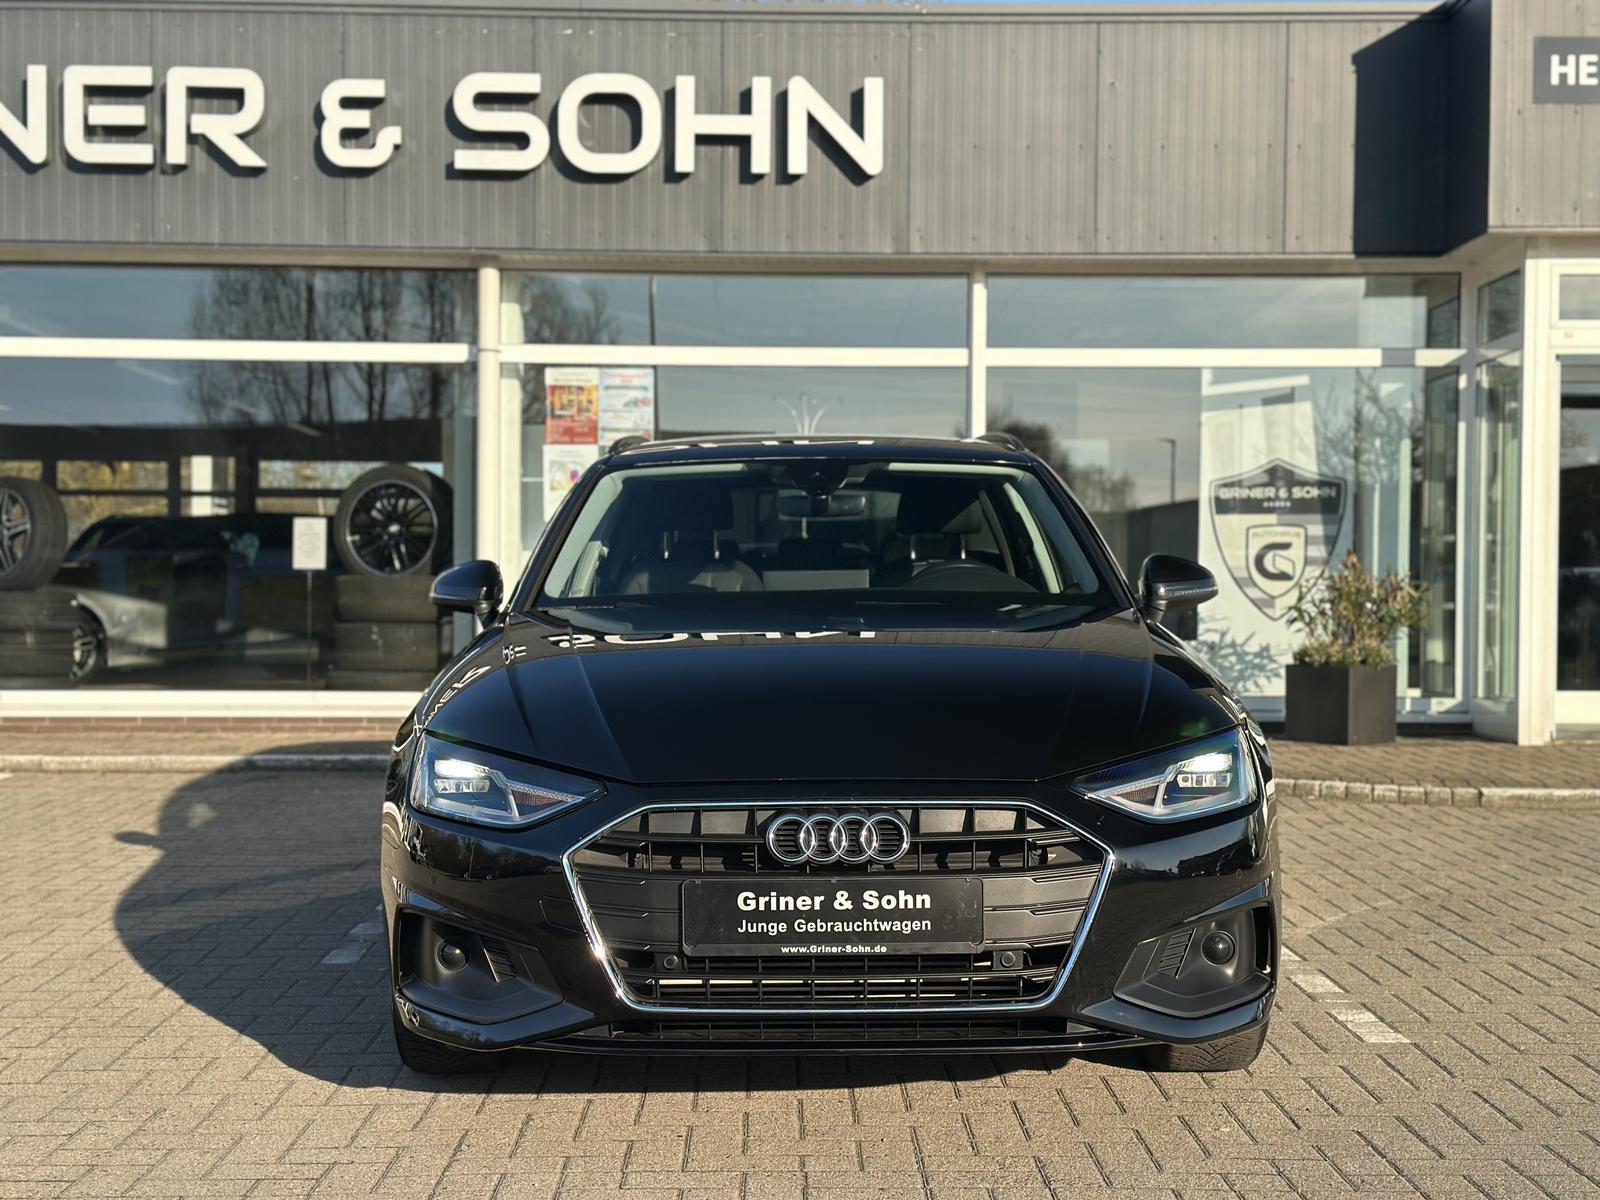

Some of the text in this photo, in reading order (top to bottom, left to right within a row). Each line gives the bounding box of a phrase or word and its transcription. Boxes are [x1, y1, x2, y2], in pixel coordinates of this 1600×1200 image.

[1549, 54, 1600, 87] HE
[320, 78, 403, 169] &
[452, 72, 885, 176] SOHN
[1219, 487, 1276, 499] GRINER
[1291, 486, 1336, 498] SOHN
[736, 889, 932, 912] Griner & Sohn
[737, 917, 933, 936] Junge Gebrauchtwagen
[780, 944, 888, 954] www.Griner-Sohn.de
